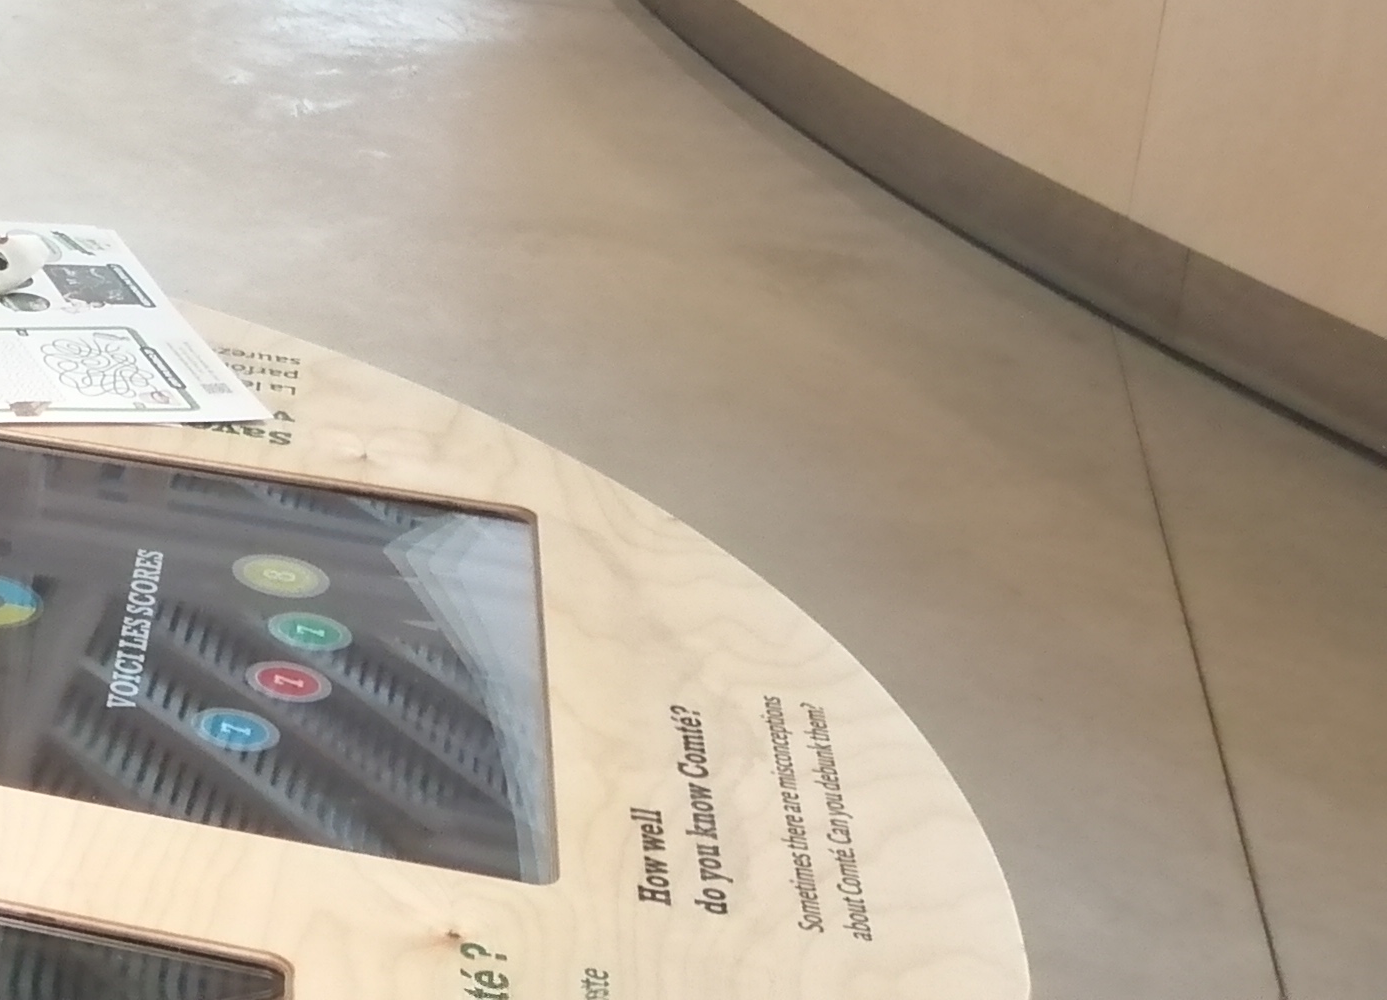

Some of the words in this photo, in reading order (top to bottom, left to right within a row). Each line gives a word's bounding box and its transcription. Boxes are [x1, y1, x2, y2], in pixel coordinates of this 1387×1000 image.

[125, 548, 164, 617] SCORES
[263, 568, 296, 583] 8
[118, 616, 152, 652] LES
[106, 650, 145, 708] VOICI
[669, 705, 709, 779] Comté?
[760, 695, 797, 790] misconceptions
[800, 702, 830, 741] them?
[807, 742, 841, 790] debunk
[685, 782, 718, 840] know
[781, 791, 801, 813] are
[825, 792, 854, 820] you
[630, 807, 666, 851] well
[781, 814, 808, 850] there
[827, 817, 852, 845] Can
[637, 856, 671, 907] How
[696, 843, 734, 884] you
[694, 887, 728, 915] do
[789, 852, 824, 933] Sometimes
[842, 896, 873, 942] about
